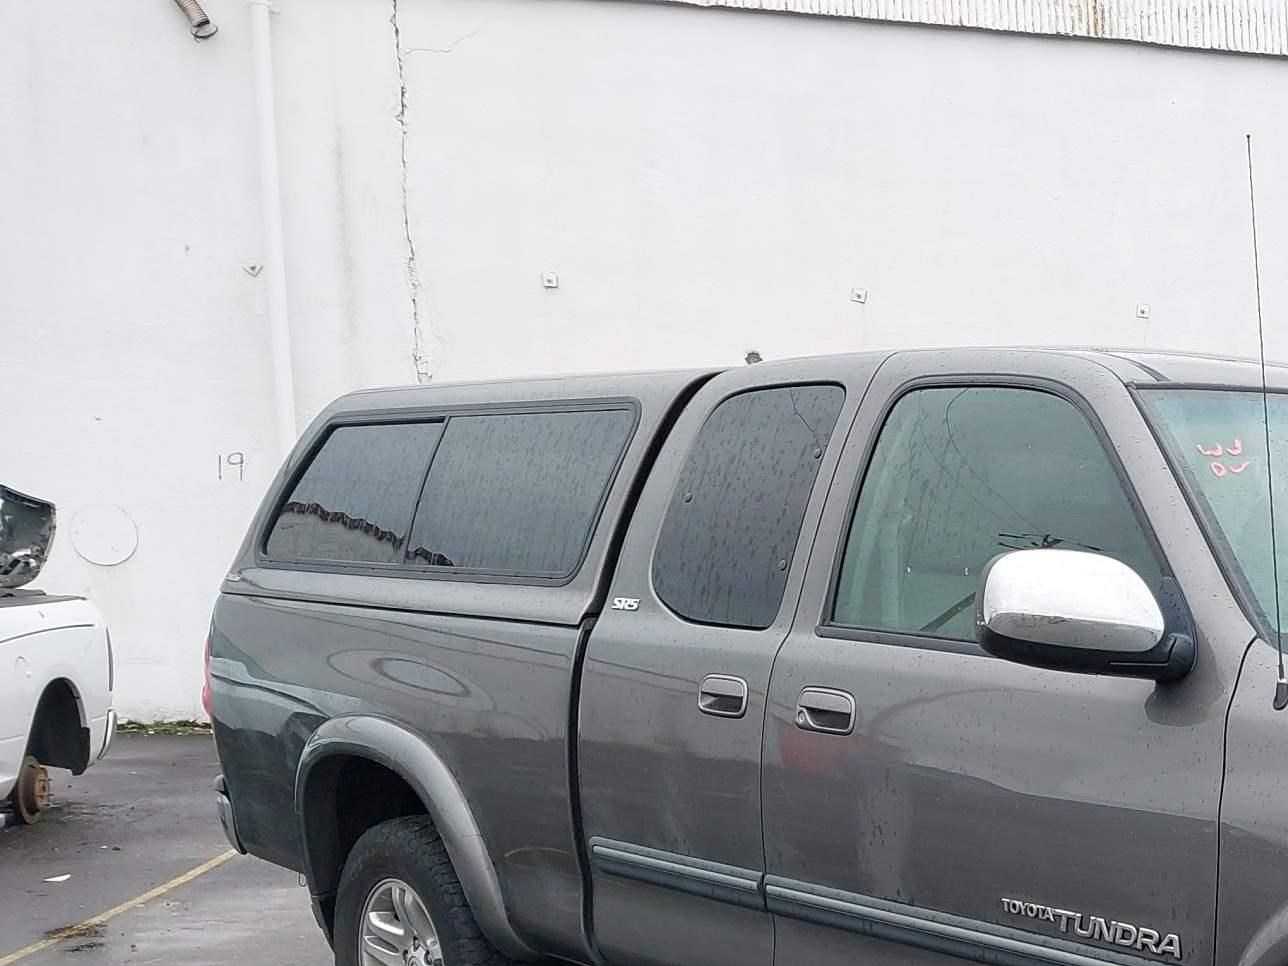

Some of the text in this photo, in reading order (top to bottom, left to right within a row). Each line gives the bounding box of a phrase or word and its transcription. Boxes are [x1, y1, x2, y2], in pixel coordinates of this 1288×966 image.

[218, 452, 245, 481] 19
[1001, 898, 1182, 960] TOYOTA TUNDRA
